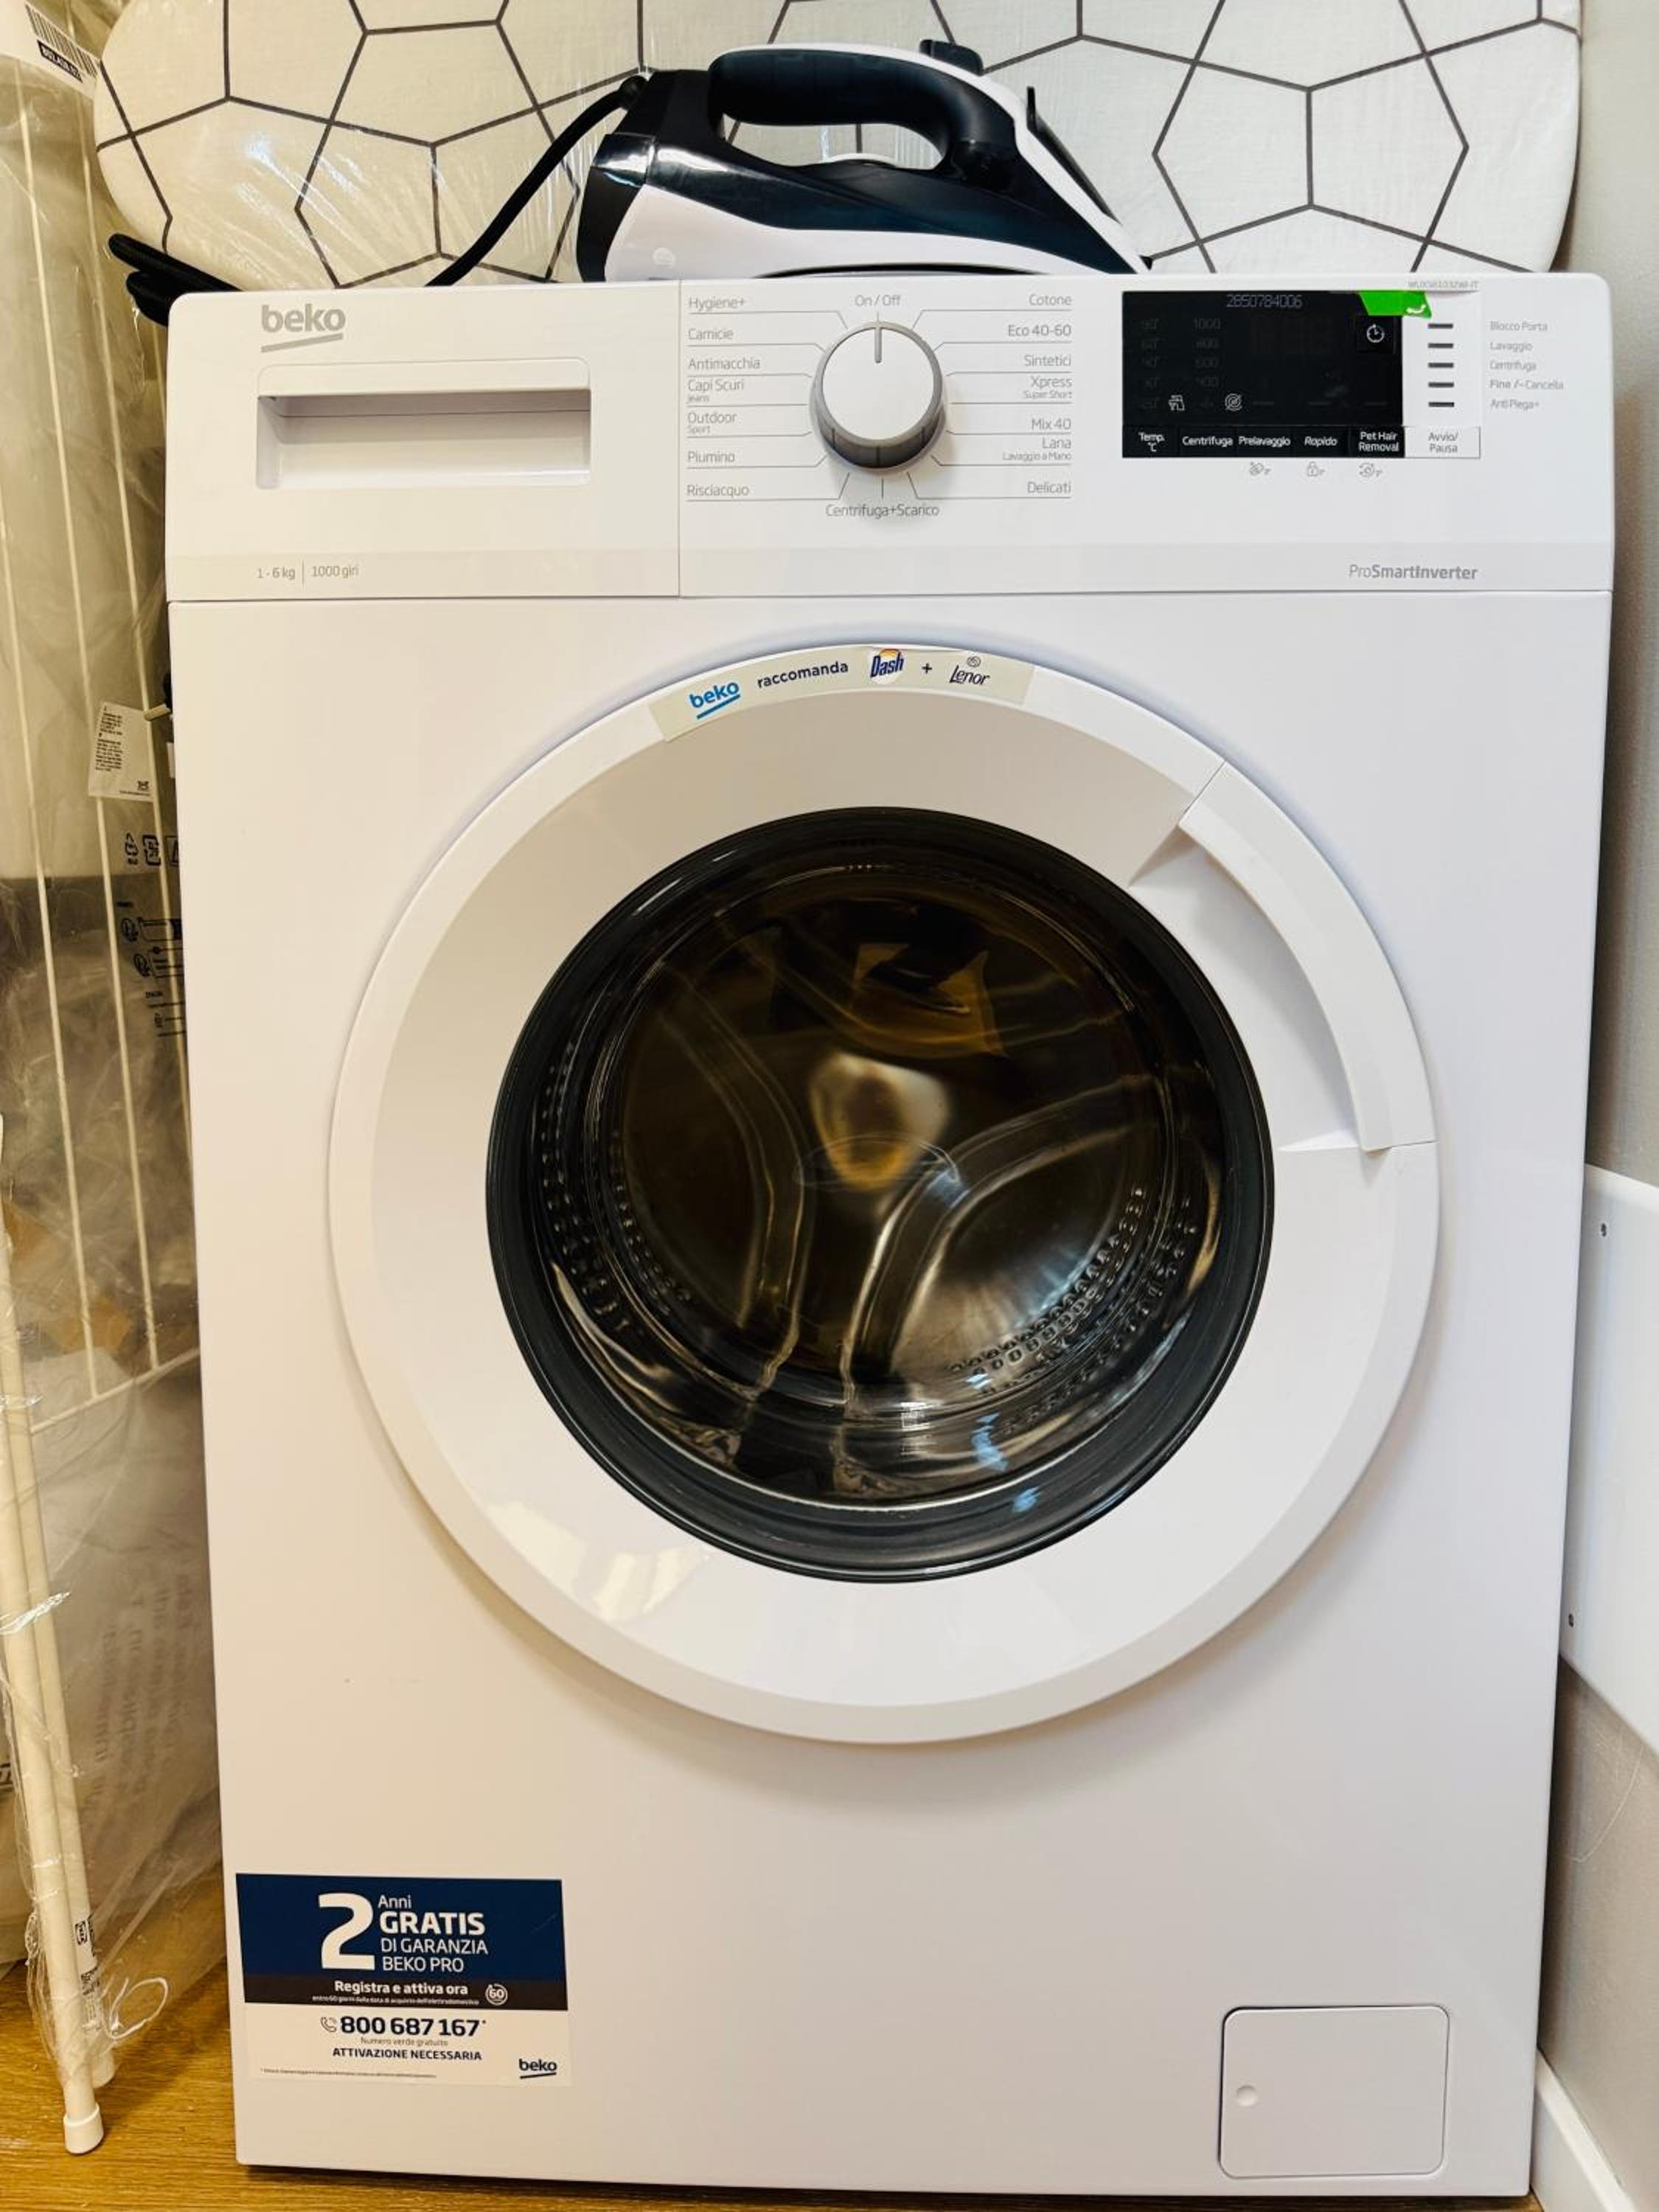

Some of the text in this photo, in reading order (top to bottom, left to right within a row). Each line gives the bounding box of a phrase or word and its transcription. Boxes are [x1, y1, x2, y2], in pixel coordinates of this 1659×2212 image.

[689, 296, 746, 311] Hygiene+
[855, 295, 871, 306] On
[883, 294, 901, 306] Off
[1029, 293, 1072, 306] Cotone
[261, 303, 347, 333] beko
[1008, 324, 1072, 337] Eco 40-60
[1489, 321, 1548, 332] Blocco Porta
[688, 328, 734, 340] Camicie
[1489, 341, 1533, 352] Lavaggio
[689, 357, 761, 369] Antimacchia
[1023, 354, 1071, 366] Sintetici
[1489, 361, 1537, 372] Centrifuga
[688, 378, 744, 392] Capi Scuri
[1031, 376, 1072, 389] Xpress
[1489, 379, 1511, 390] Fine
[1526, 379, 1564, 391] Cancella
[1490, 398, 1509, 408] Anti
[687, 411, 737, 424] Outdoor
[1032, 417, 1071, 430] Mix 40
[687, 424, 711, 434] Sport
[1360, 431, 1398, 440] Pet Hair
[1042, 437, 1071, 449] Lana
[1138, 431, 1165, 442] Temp.
[1181, 436, 1234, 448] Centrifuga
[1238, 436, 1291, 448] Prelavaggio
[1304, 436, 1338, 448] Rapido
[1428, 432, 1459, 442] Avvio/
[1358, 442, 1399, 452] Removal
[1429, 444, 1458, 453] Pausa
[688, 450, 735, 463] Piumino
[686, 484, 751, 498] Risciacquo
[1026, 481, 1072, 493] Delicati
[825, 504, 940, 518] Centrifuga+Scarico
[272, 567, 280, 579] 6
[282, 566, 296, 580] kg
[312, 563, 360, 579] 1000 giri
[1349, 564, 1478, 580] ProSmartInverter
[689, 681, 740, 710] beko
[757, 660, 849, 689] raccomanda
[869, 653, 905, 678] Dash
[948, 666, 990, 686] Lenor
[378, 1894, 412, 1908] Anni
[380, 1911, 485, 1935] GRATIS
[318, 1892, 375, 1971] 2
[380, 1938, 488, 1955] DI GARANZIA
[382, 1956, 465, 1973] BEKO PRO
[334, 1980, 468, 1995] Registra e attiva ora
[489, 1989, 505, 1999] 60
[340, 2015, 386, 2034] 800
[389, 2017, 434, 2036] 687
[361, 2037, 449, 2048] Numero verde gratuito
[332, 2048, 483, 2061] ATTIVAZIONE NECESSARIA
[518, 2059, 557, 2073] beko
